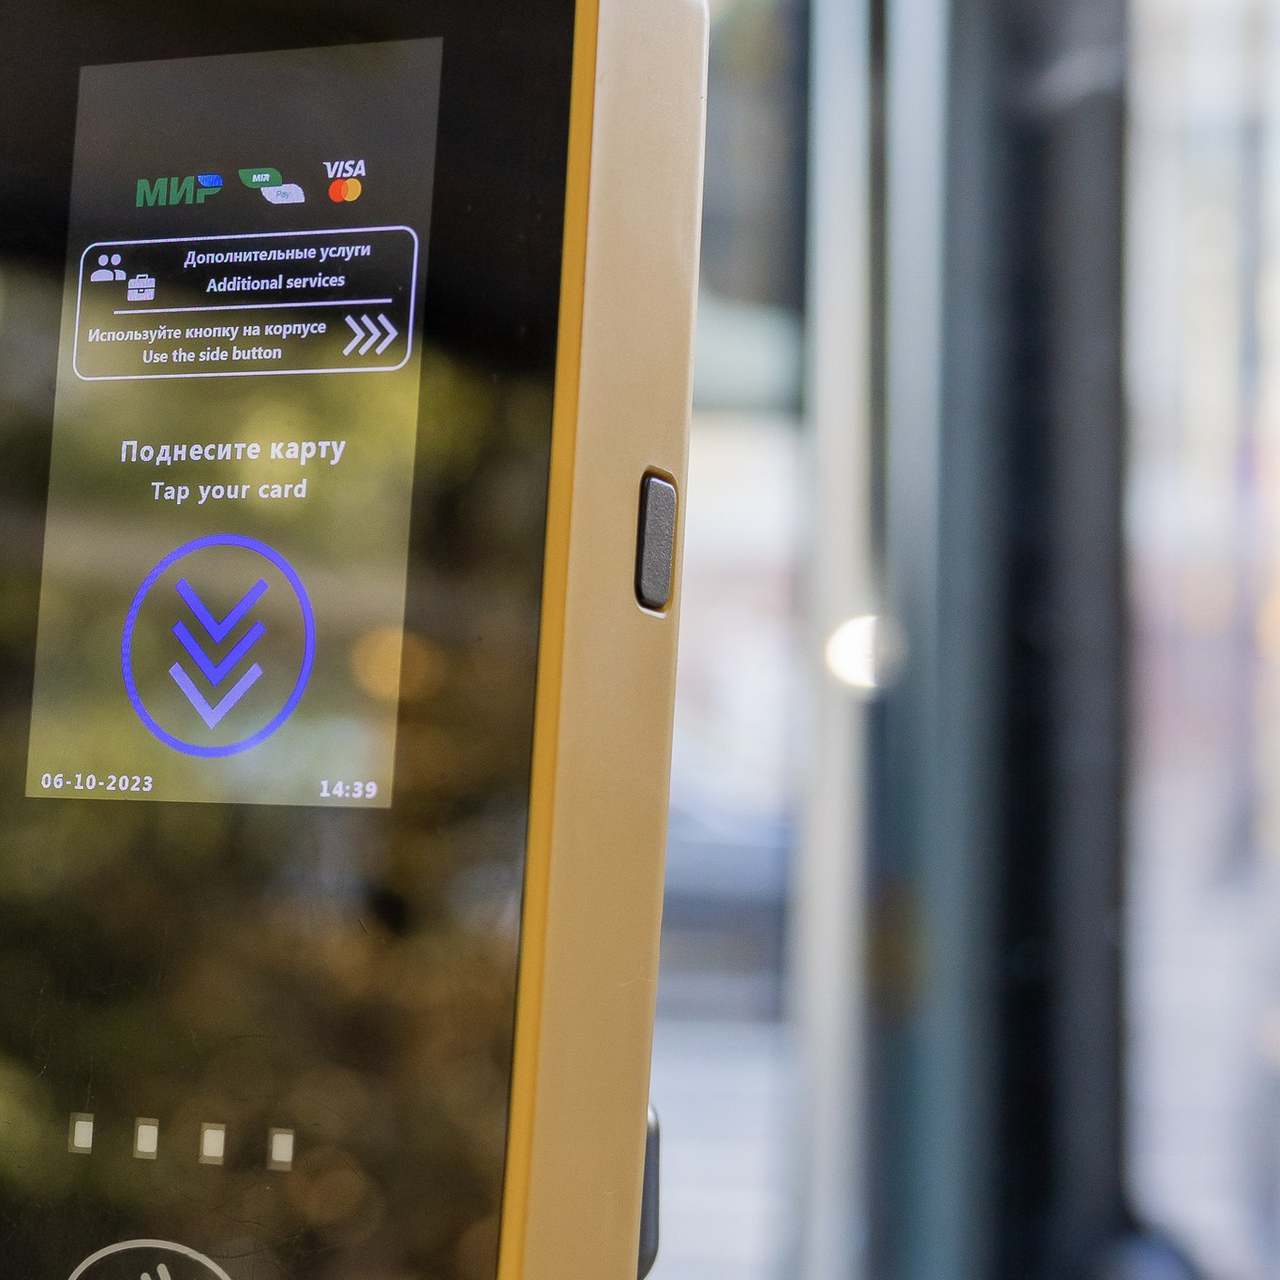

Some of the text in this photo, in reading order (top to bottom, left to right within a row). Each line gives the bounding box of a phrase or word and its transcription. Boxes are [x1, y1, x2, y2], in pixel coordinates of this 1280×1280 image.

[252, 173, 271, 184] MIR
[322, 159, 366, 179] VISA
[135, 174, 223, 208] МИР
[183, 244, 371, 269] Дополнительные услуги
[206, 272, 346, 293] Additional services
[87, 322, 327, 345] Используйте кнопку на корпусе
[142, 345, 282, 364] Use the side button
[120, 440, 346, 466] Поднесите карту
[151, 478, 308, 505] Tap your card
[41, 773, 153, 792] 06-10-2023
[319, 779, 378, 799] 14:39
